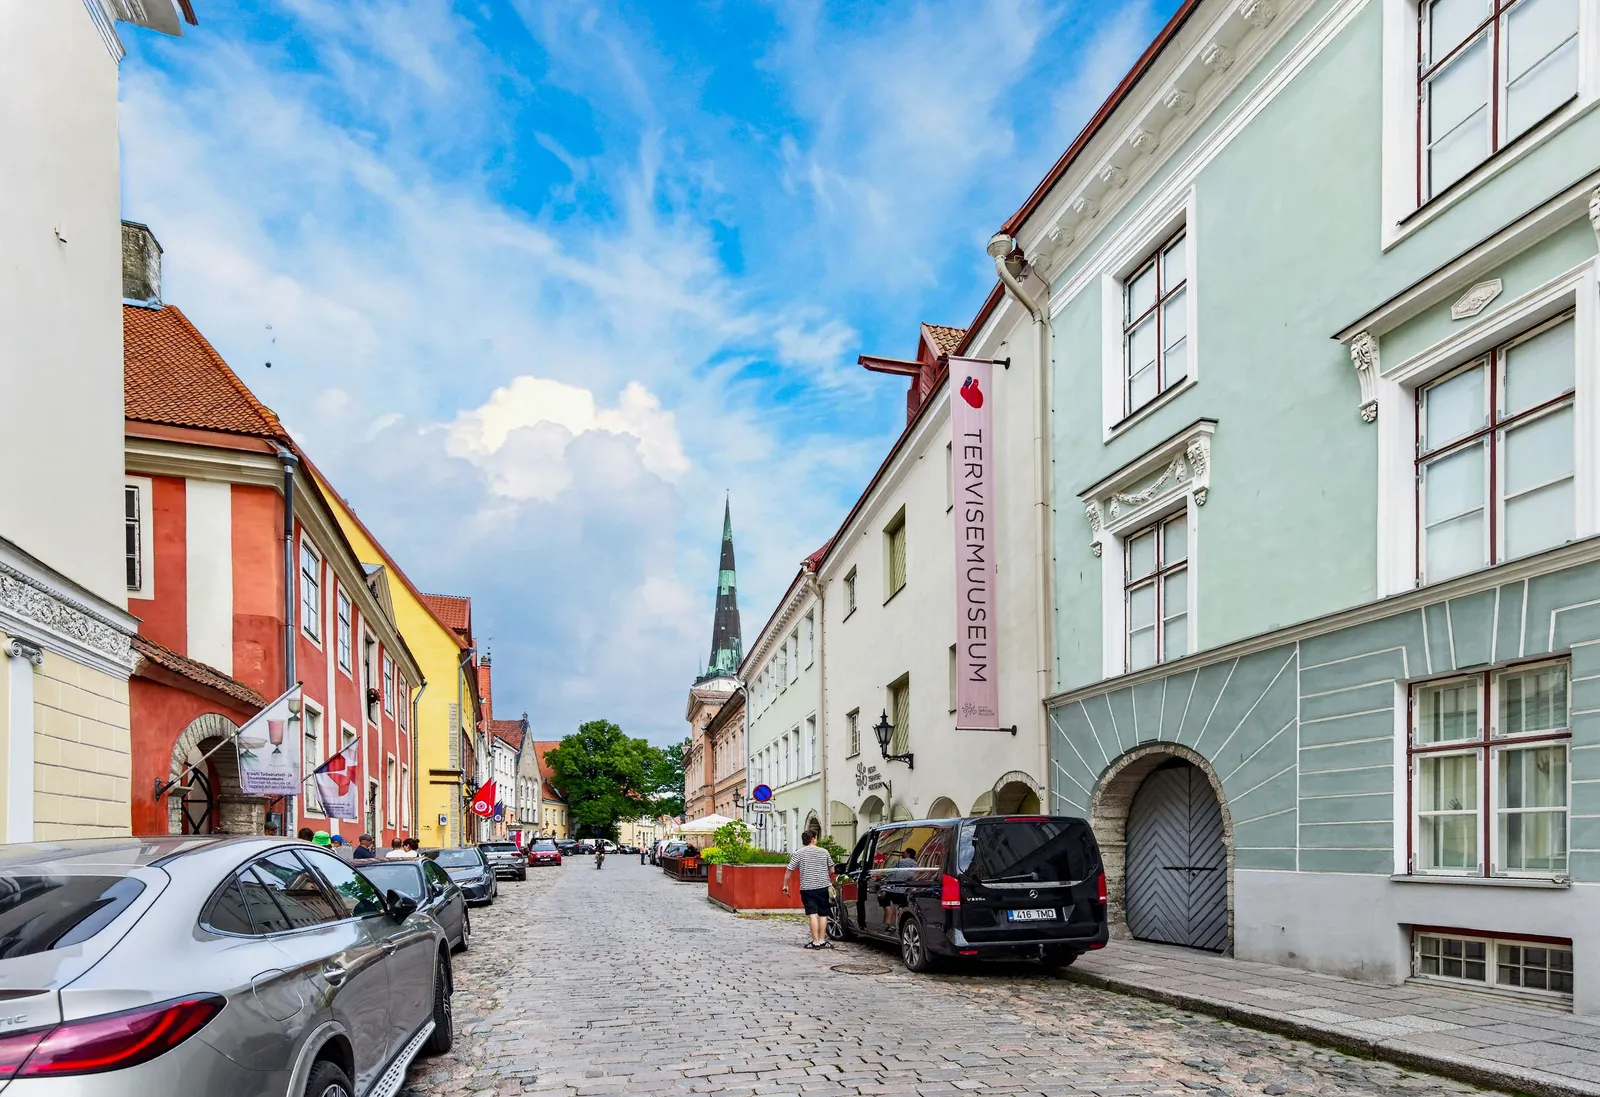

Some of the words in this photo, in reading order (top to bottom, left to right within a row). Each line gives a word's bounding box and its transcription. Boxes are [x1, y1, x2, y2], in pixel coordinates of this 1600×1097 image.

[964, 429, 987, 682] TERVISEMUUSEUM
[1017, 911, 1031, 919] 416
[1036, 910, 1054, 918] TMD
